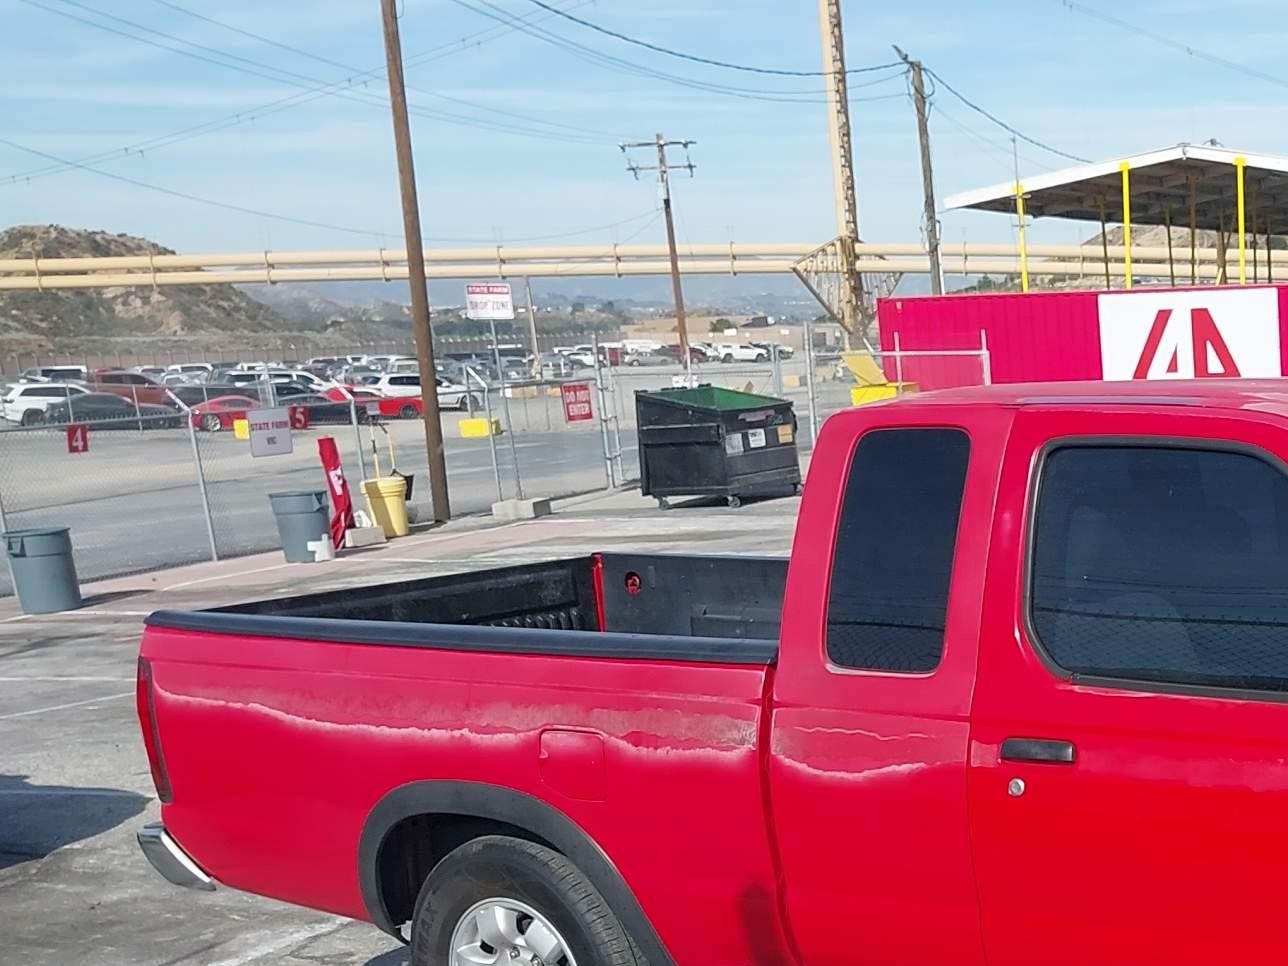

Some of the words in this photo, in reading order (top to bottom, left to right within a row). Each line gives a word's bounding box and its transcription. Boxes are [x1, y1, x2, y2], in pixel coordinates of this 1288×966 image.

[565, 390, 576, 403] DO
[576, 390, 590, 402] NOT
[295, 407, 305, 428] 5
[568, 403, 590, 416] ENTER
[72, 428, 84, 451] 4
